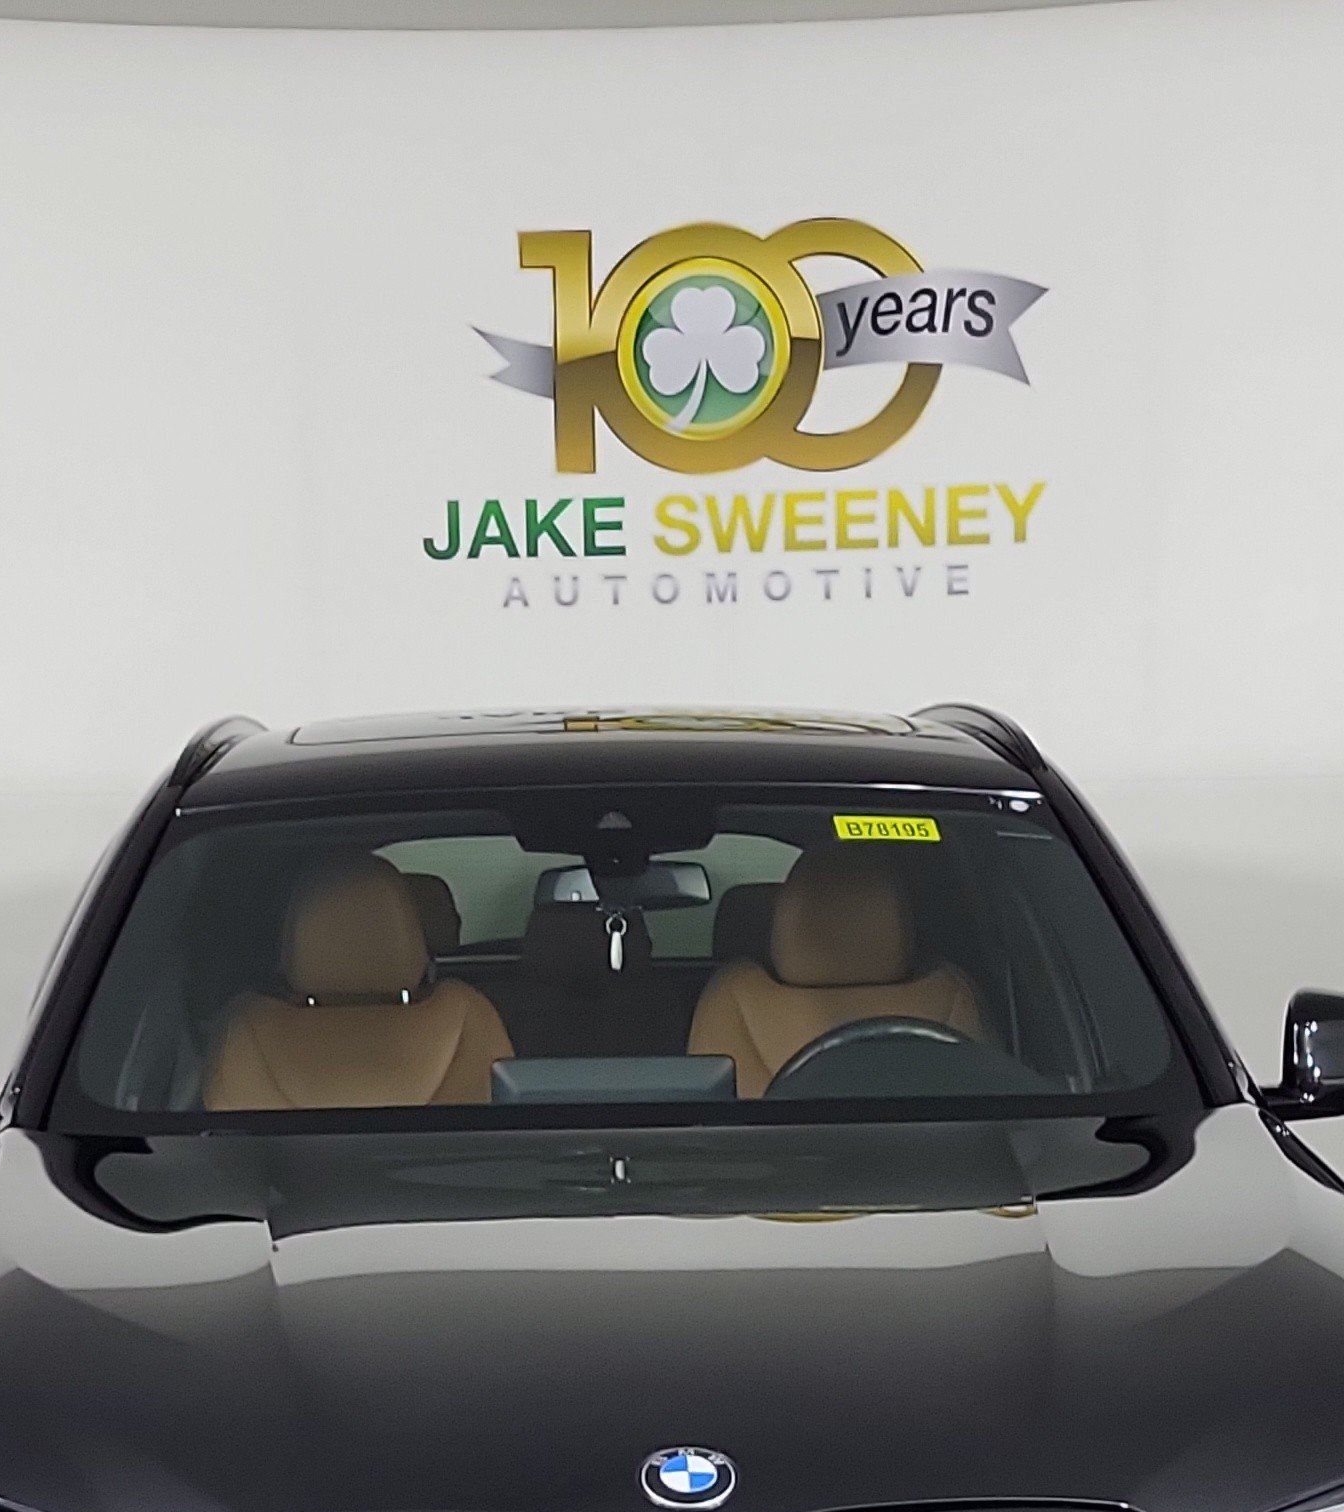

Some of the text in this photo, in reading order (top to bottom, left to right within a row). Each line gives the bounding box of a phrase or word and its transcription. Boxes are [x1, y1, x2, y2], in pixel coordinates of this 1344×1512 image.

[517, 217, 996, 474] 100 years
[423, 482, 1047, 560] JAKE SWEENEY
[503, 565, 970, 609] AUTOMOTIVE
[846, 821, 929, 838] B78195
